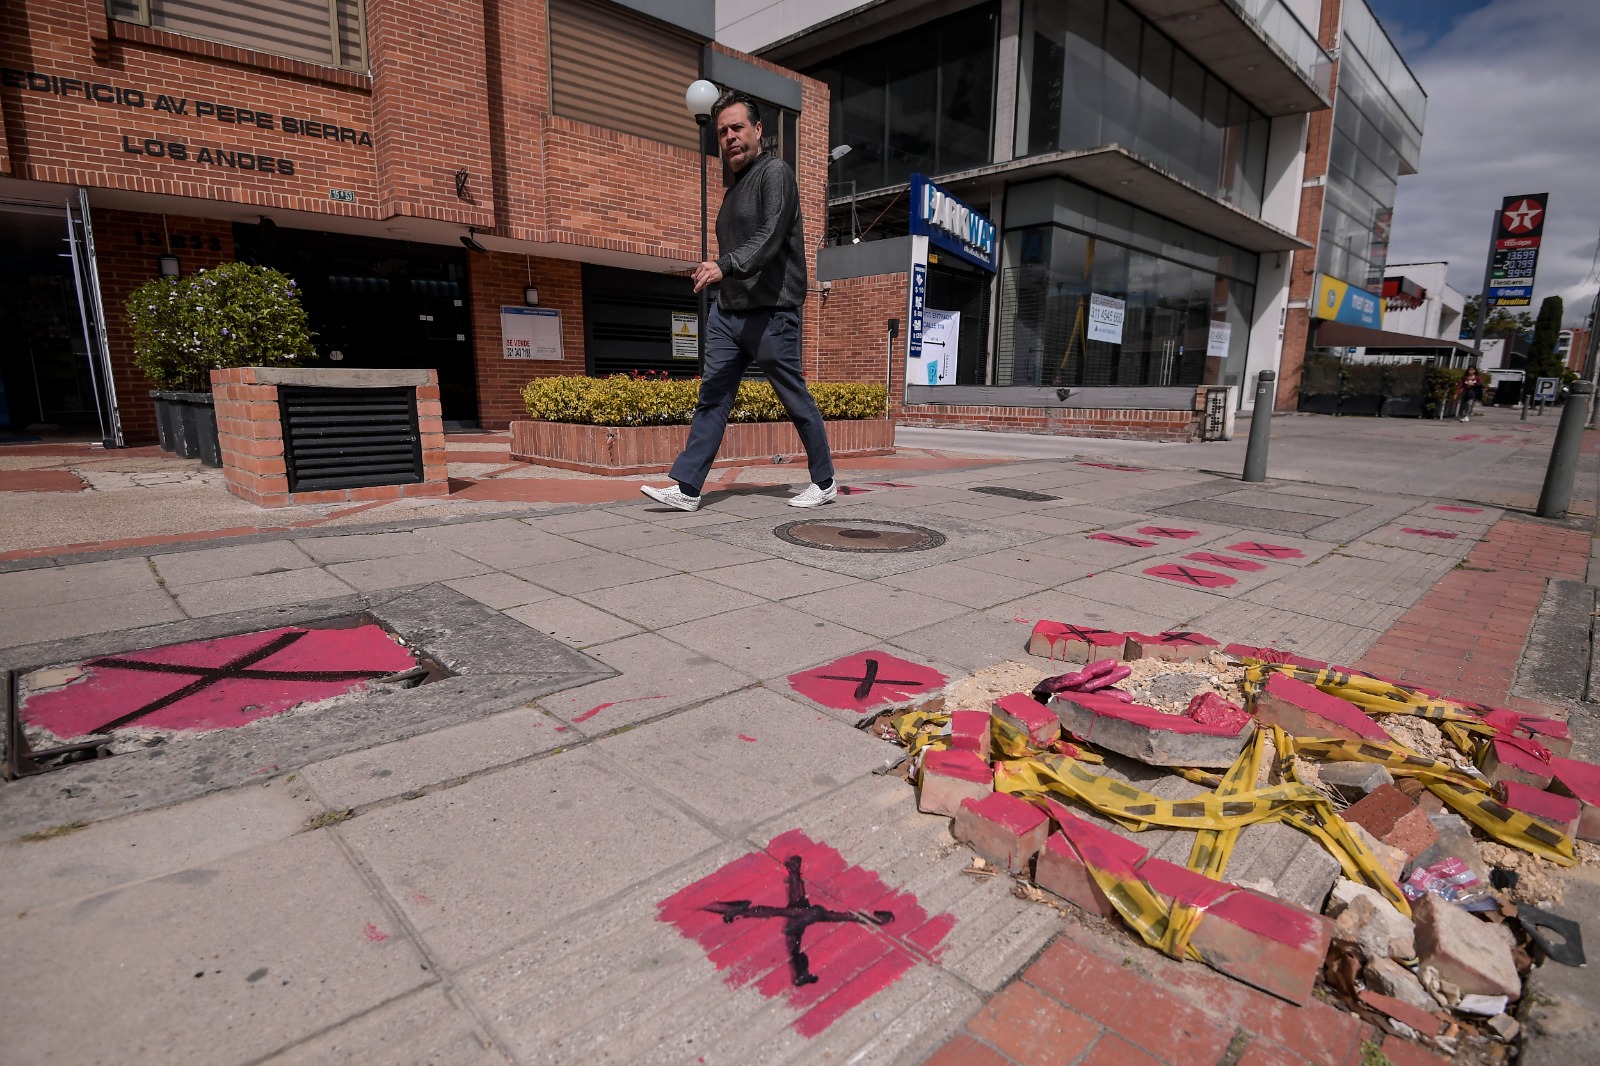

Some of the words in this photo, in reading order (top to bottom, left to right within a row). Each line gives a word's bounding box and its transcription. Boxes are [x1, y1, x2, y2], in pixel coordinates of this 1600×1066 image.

[2, 67, 145, 108] EDIFICIO
[153, 94, 188, 116] AV.
[196, 100, 274, 130] PEPE
[281, 116, 373, 148] SIERRA
[122, 135, 188, 161] LOS
[196, 146, 295, 176] ANDES
[921, 184, 995, 254] PARKWAY
[1507, 250, 1536, 260] 13.699
[1502, 260, 1534, 270] 20.799
[1507, 268, 1532, 278] 9.949
[1496, 297, 1530, 305] Havoline
[506, 339, 513, 347] SE
[514, 339, 531, 348] VENDE
[1541, 381, 1553, 394] P
